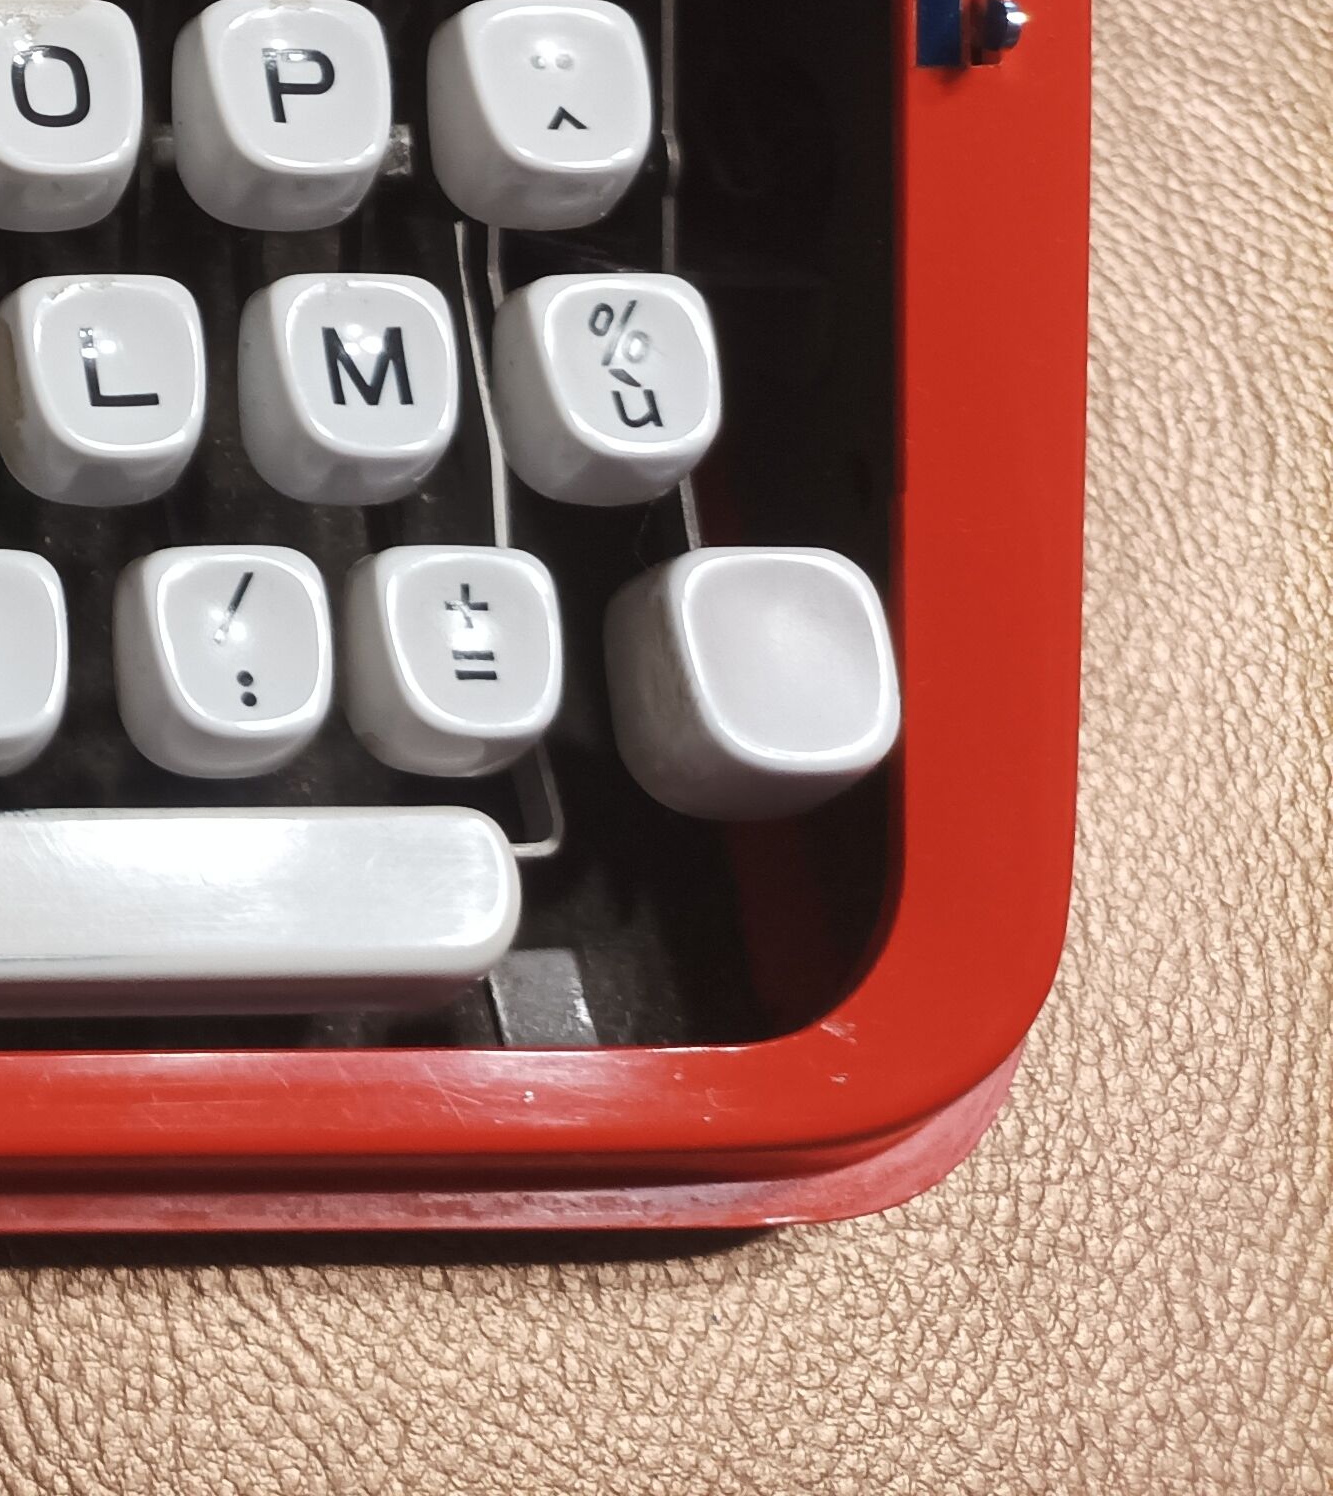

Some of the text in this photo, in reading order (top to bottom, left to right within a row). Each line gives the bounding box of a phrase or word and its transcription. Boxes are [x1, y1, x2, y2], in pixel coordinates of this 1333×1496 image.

[12, 45, 90, 127] O
[261, 47, 335, 123] P
[79, 327, 160, 407] L
[323, 327, 413, 405] M
[589, 300, 651, 366] %
[608, 368, 664, 428] ù
[452, 650, 498, 681] =
